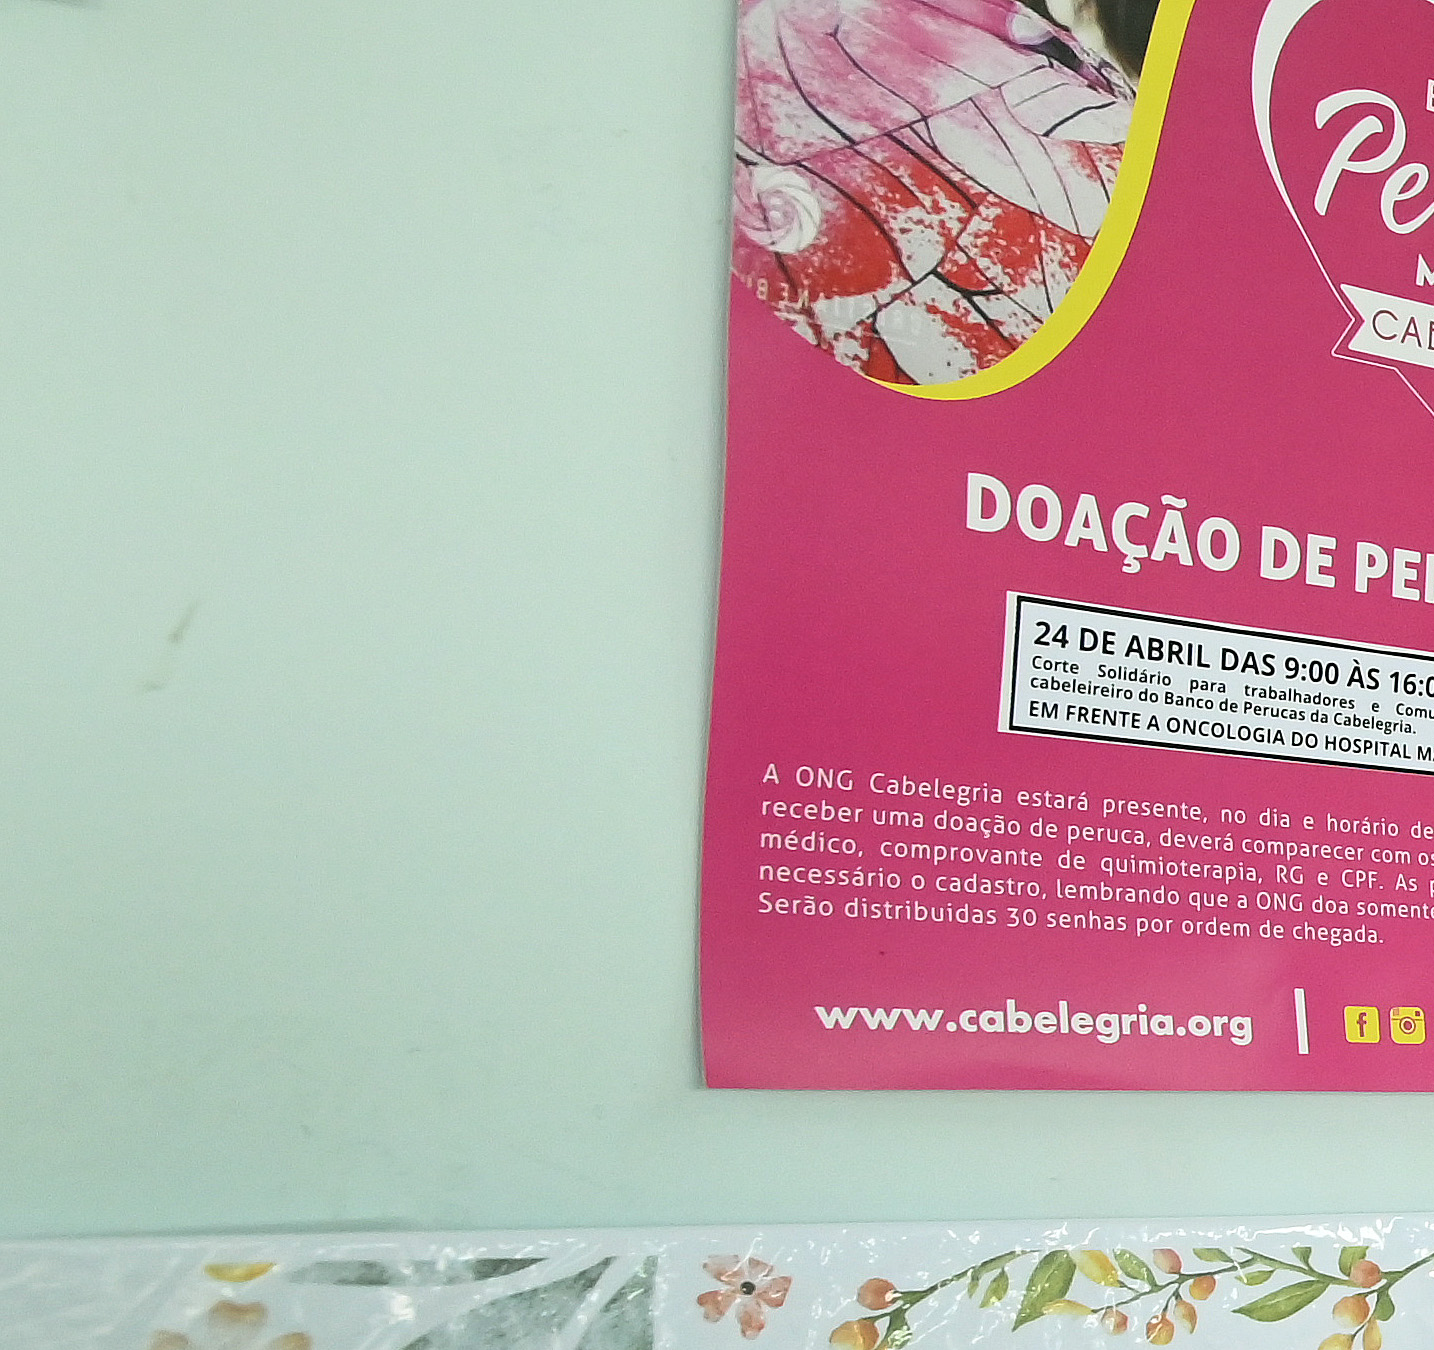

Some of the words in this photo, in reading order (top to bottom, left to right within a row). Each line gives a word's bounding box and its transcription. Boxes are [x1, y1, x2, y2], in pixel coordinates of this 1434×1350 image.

[967, 473, 1239, 573] DOAÇÃO
[1260, 526, 1336, 587] DE
[1033, 656, 1079, 674] Corte
[1098, 665, 1171, 686] Solidário
[1190, 680, 1225, 693] para
[1244, 684, 1355, 709] trabalhadores
[1372, 703, 1379, 712] e
[1034, 622, 1069, 648] 24
[1080, 628, 1115, 655] DE
[1124, 635, 1210, 669] ABRIL
[1222, 648, 1275, 676] DAS
[1285, 657, 1338, 684] 9:00
[1347, 659, 1379, 689] ÀS
[1030, 701, 1058, 719] EM
[1067, 705, 1141, 729] FRENTE
[1147, 715, 1159, 731] A
[1167, 718, 1285, 745] ONCOLOGIA
[1292, 732, 1318, 748] DO
[1325, 736, 1411, 759] HOSPITAL
[1031, 676, 1132, 699] cabeleireiro
[1139, 688, 1158, 702] do
[1165, 692, 1213, 709] Banco
[1219, 698, 1238, 712] de
[1243, 702, 1306, 720] Perucas
[1311, 710, 1328, 723] da
[1334, 713, 1416, 734] Cabelegria.
[763, 764, 779, 784] A
[796, 766, 852, 790] ONG
[870, 773, 1001, 806] Cabelegria
[1018, 791, 1087, 810] estará
[1104, 799, 1207, 823] presente,
[1222, 809, 1245, 823] no
[1260, 808, 1289, 827] dia
[1304, 816, 1313, 829] e
[1328, 813, 1398, 836] horário
[761, 830, 862, 857] médico,
[881, 842, 1042, 866] comprovante
[1058, 850, 1085, 869] de
[1101, 855, 1262, 884] quimioterapia,
[1277, 865, 1303, 884] RG
[1318, 872, 1328, 885] e
[1342, 870, 1383, 889] CPF.
[1396, 874, 1417, 891] As
[763, 800, 863, 822] receber
[873, 810, 923, 827] uma
[935, 810, 1020, 838] doação
[1030, 818, 1057, 838] de
[1068, 826, 1150, 847] peruca,
[1160, 828, 1233, 851] deverá
[1242, 839, 1364, 860] comparecer
[1372, 849, 1410, 864] com
[759, 892, 833, 916] Serão
[845, 898, 996, 924] distribuidas
[1007, 908, 1036, 927] 30
[1047, 910, 1126, 930] senhas
[1137, 918, 1173, 936] por
[1182, 917, 1250, 937] ordem
[1260, 920, 1283, 938] de
[1293, 922, 1383, 946] chegada.
[760, 866, 900, 888] necessário
[912, 875, 925, 889] o
[936, 874, 1046, 899] cadastro,
[1057, 879, 1179, 904] lembrando
[1189, 892, 1228, 911] que
[1238, 895, 1247, 908] a
[1257, 892, 1302, 911] ONG
[1312, 895, 1348, 914] doa
[815, 999, 1252, 1045] www.cabelegria.org
